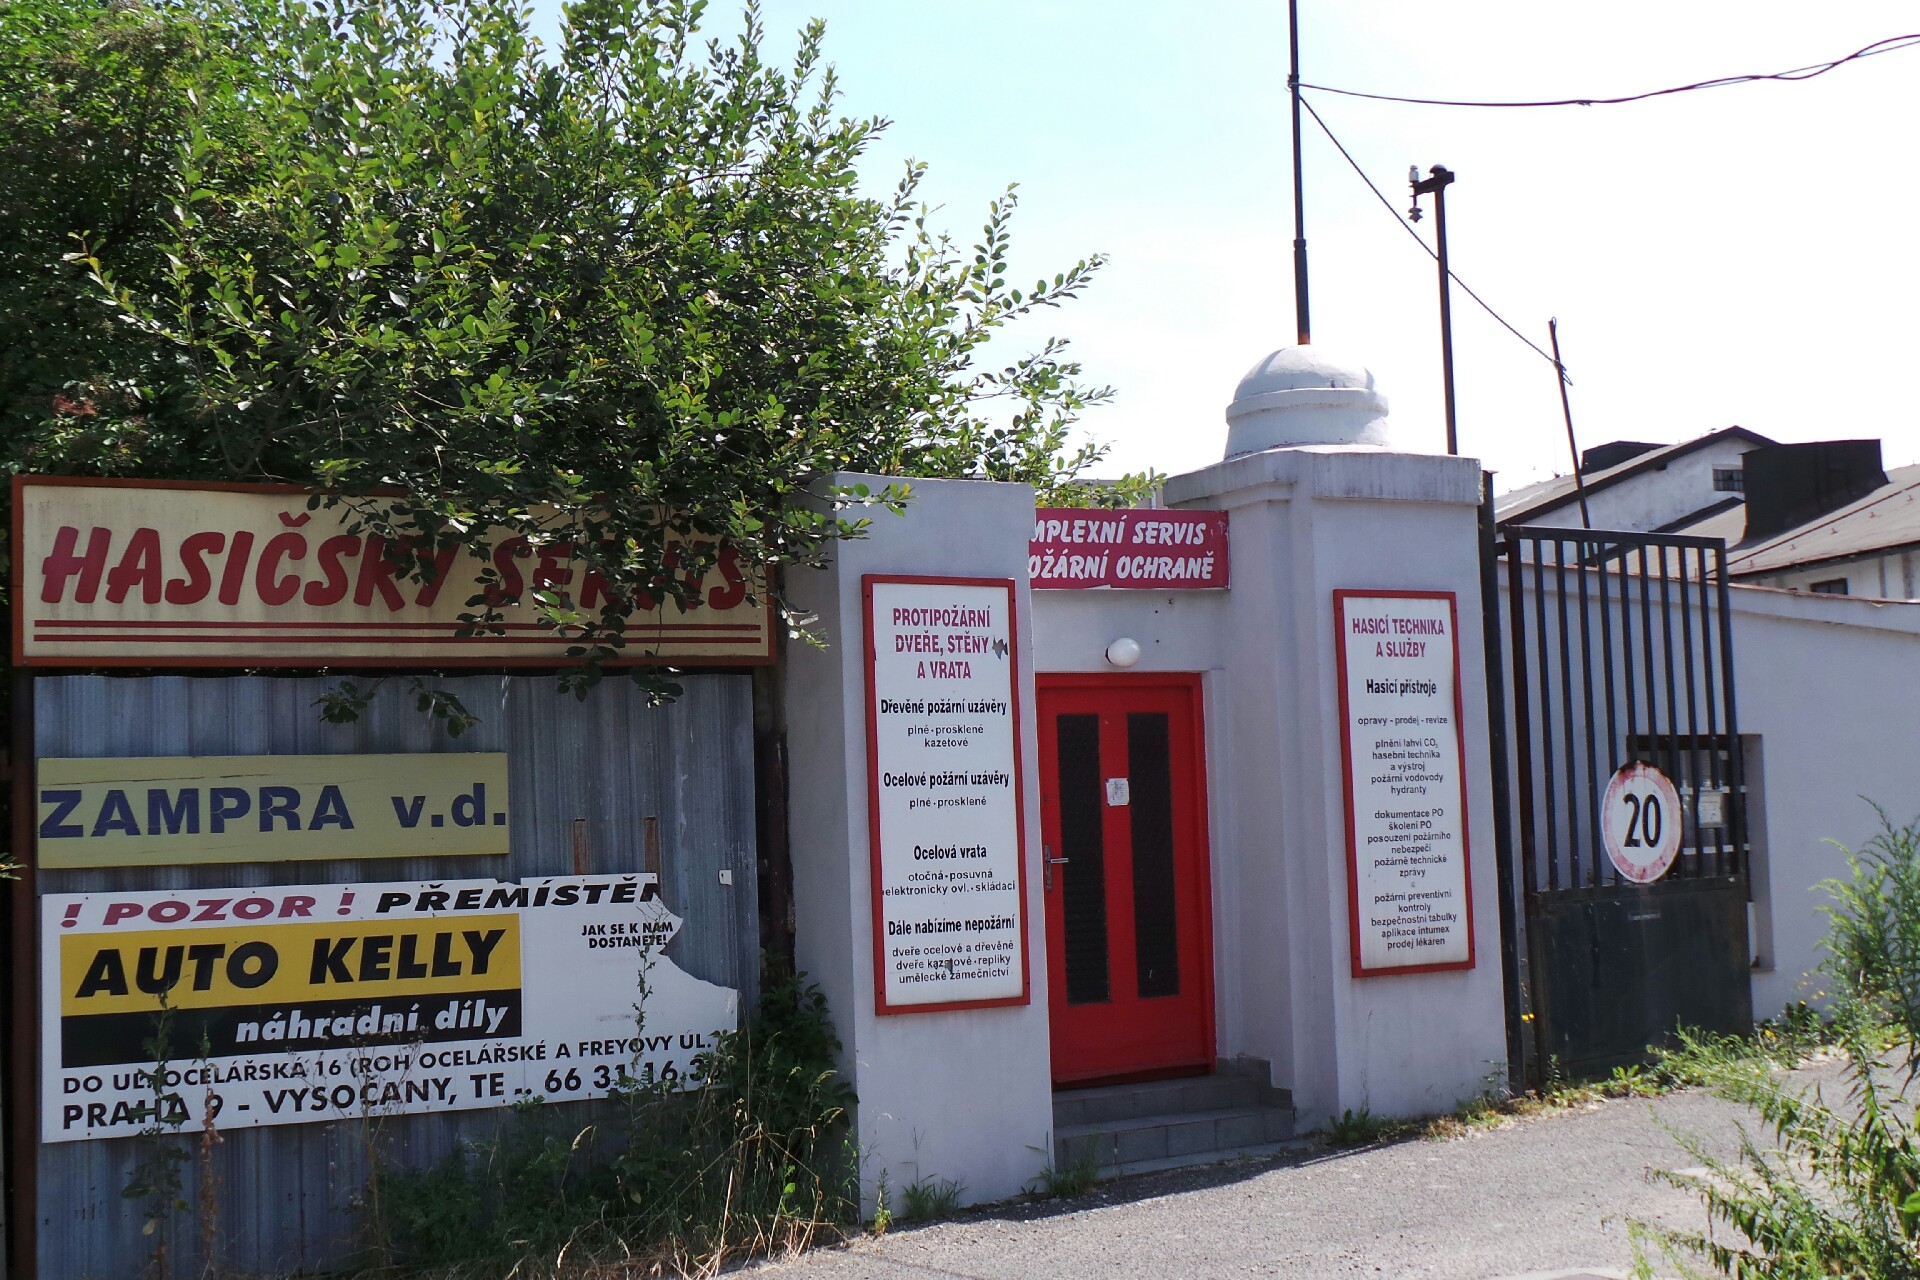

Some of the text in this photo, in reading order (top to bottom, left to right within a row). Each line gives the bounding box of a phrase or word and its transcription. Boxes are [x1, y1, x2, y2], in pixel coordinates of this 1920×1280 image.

[1133, 521, 1207, 546] SERVIS
[1116, 550, 1214, 580] OCHRANĚ
[893, 604, 991, 628] PROTIPOŽÁRNÍ
[1352, 614, 1445, 636] HASICÍ TECHNIKA
[895, 630, 990, 656] DVEŘE, STĚNY
[1376, 637, 1426, 658] A SLUŽBY
[917, 661, 971, 679] A VRATA
[1399, 679, 1437, 697] přístroje
[880, 698, 1007, 716] Dřevěné požární uzávěry
[1357, 716, 1388, 727] opravy
[1394, 715, 1420, 726] prodej
[1425, 715, 1448, 725] revize
[907, 723, 984, 737] plné prosklené
[924, 737, 969, 748] kazetové
[1372, 750, 1441, 760] hasební technika
[1390, 761, 1425, 773] a výstroj
[883, 770, 1010, 789] Ocelové požární uzávěry
[1405, 772, 1444, 784] vodovody
[1390, 785, 1427, 796] hydranty
[39, 782, 508, 839] ZAMPRA v.d.
[909, 796, 986, 809] plné prosklené
[1374, 808, 1444, 820] dokumentace PO
[1623, 792, 1662, 848] 20
[1420, 820, 1432, 830] PO
[913, 843, 987, 861] Ocelová vrata
[1374, 856, 1409, 869] požárně
[908, 868, 993, 883] otočná posuvná
[885, 880, 1015, 897] elektronicky ovl. skládací
[102, 895, 317, 926] POZOR
[1398, 903, 1431, 914] kontroly
[888, 914, 1015, 936] Dále nabízíme nepožární
[1428, 912, 1457, 924] tabulky
[581, 923, 608, 937] JAK
[610, 923, 626, 936] SE
[629, 922, 639, 935] K
[1381, 925, 1450, 939] aplikace intumex
[588, 934, 668, 949] DOSTANETE!
[892, 940, 1014, 958] dveře ocelové a dřevěné
[1387, 939, 1414, 951] prodej
[75, 929, 506, 998] AUTO KELLY
[896, 958, 924, 971] dveře
[978, 954, 1011, 967] repliky
[899, 971, 947, 984] umělecké
[236, 999, 509, 1043] náhradní díly
[63, 1075, 103, 1094] DO
[163, 1057, 308, 1089] OCELÁŘSKÁ
[317, 1059, 342, 1077] 16
[350, 1051, 411, 1079] (ROH
[419, 1039, 546, 1070] OCELÁŘSKÉ
[555, 1043, 571, 1059] A
[578, 1035, 674, 1058] FREYOVY
[63, 1096, 191, 1130] PRAHA
[263, 1073, 458, 1115] VYSOČANY,
[545, 1068, 582, 1094] 66
